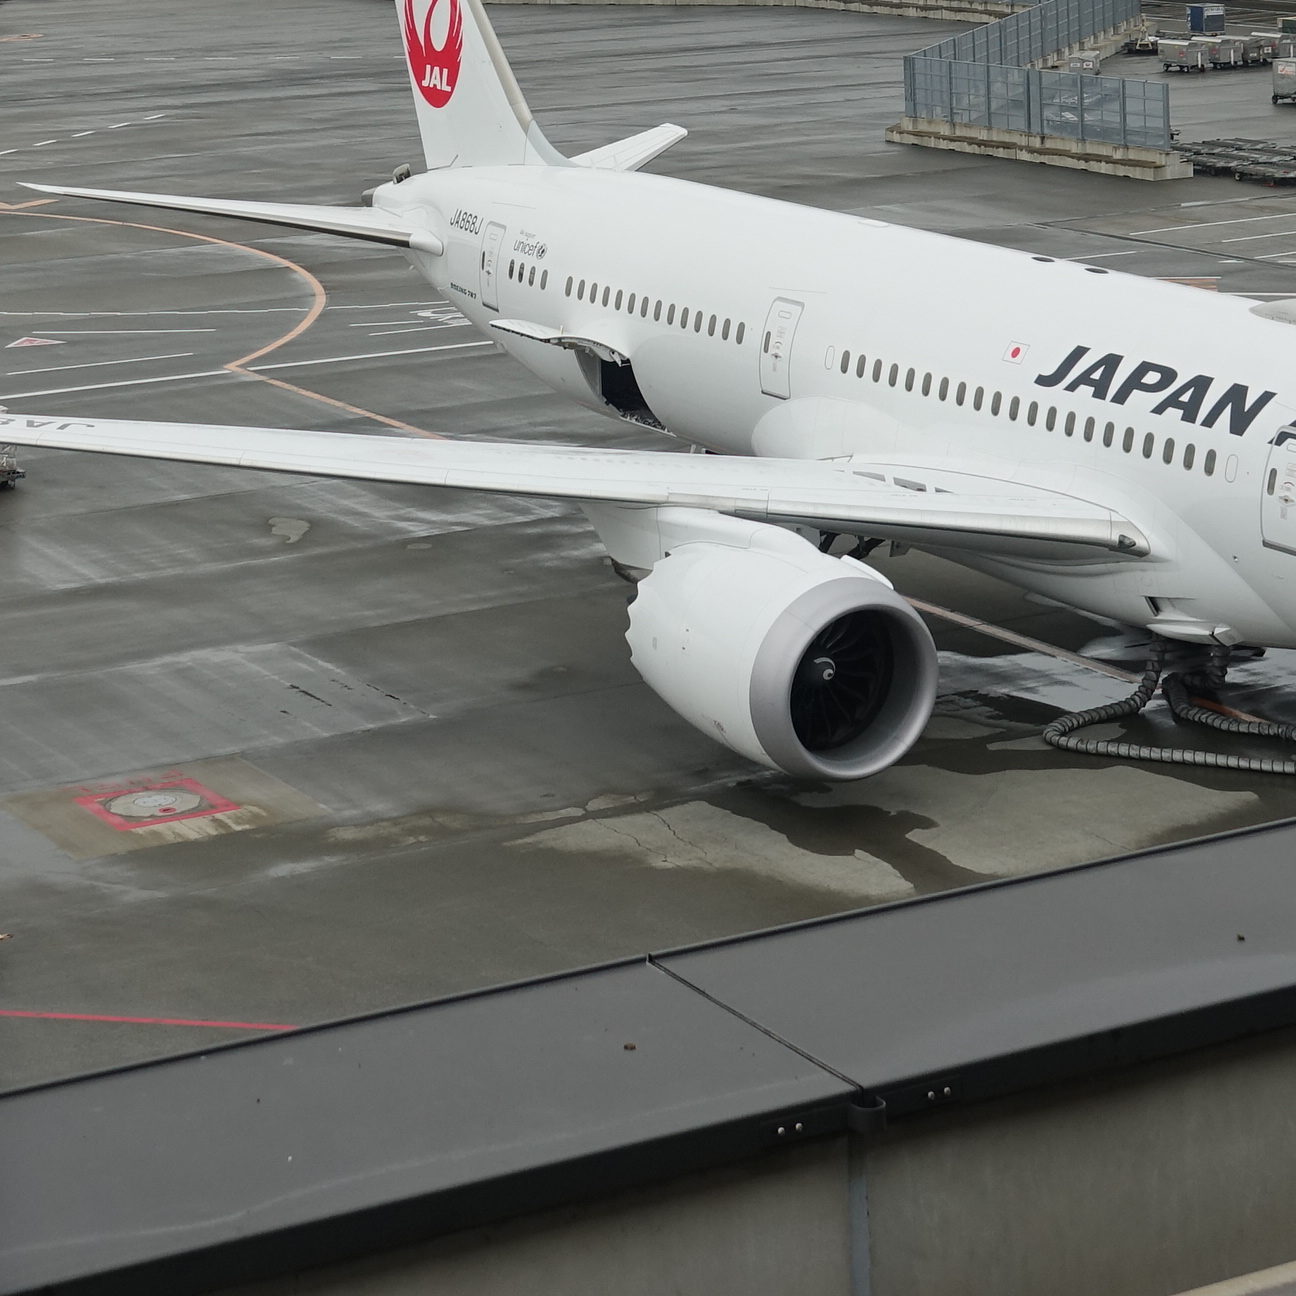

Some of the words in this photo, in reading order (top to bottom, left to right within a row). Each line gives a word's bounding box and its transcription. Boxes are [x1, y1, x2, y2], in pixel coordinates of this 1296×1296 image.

[421, 64, 452, 92] JAL
[450, 208, 484, 235] JA868J
[513, 239, 539, 257] unicef
[1034, 344, 1276, 438] JAPAN
